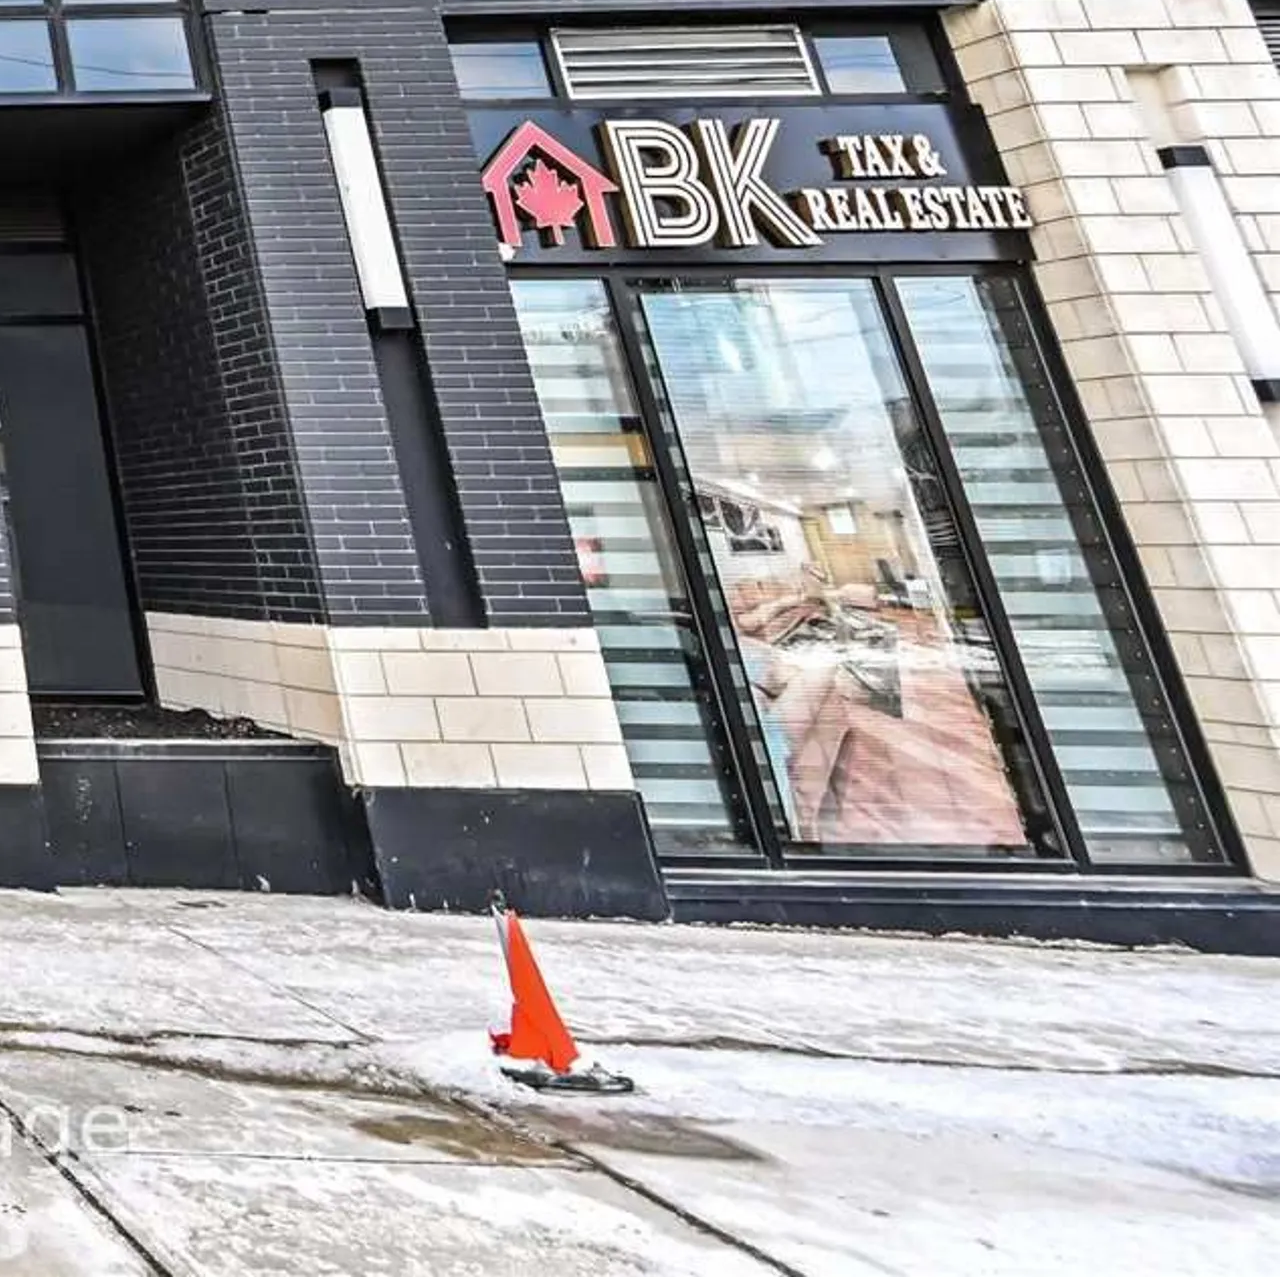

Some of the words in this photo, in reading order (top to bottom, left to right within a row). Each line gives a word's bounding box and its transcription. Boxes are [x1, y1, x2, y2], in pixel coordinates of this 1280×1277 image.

[836, 134, 908, 178] TAX
[911, 132, 948, 176] &
[603, 118, 825, 248] BK
[801, 187, 904, 231] REAL
[905, 186, 1035, 230] ESTATE
